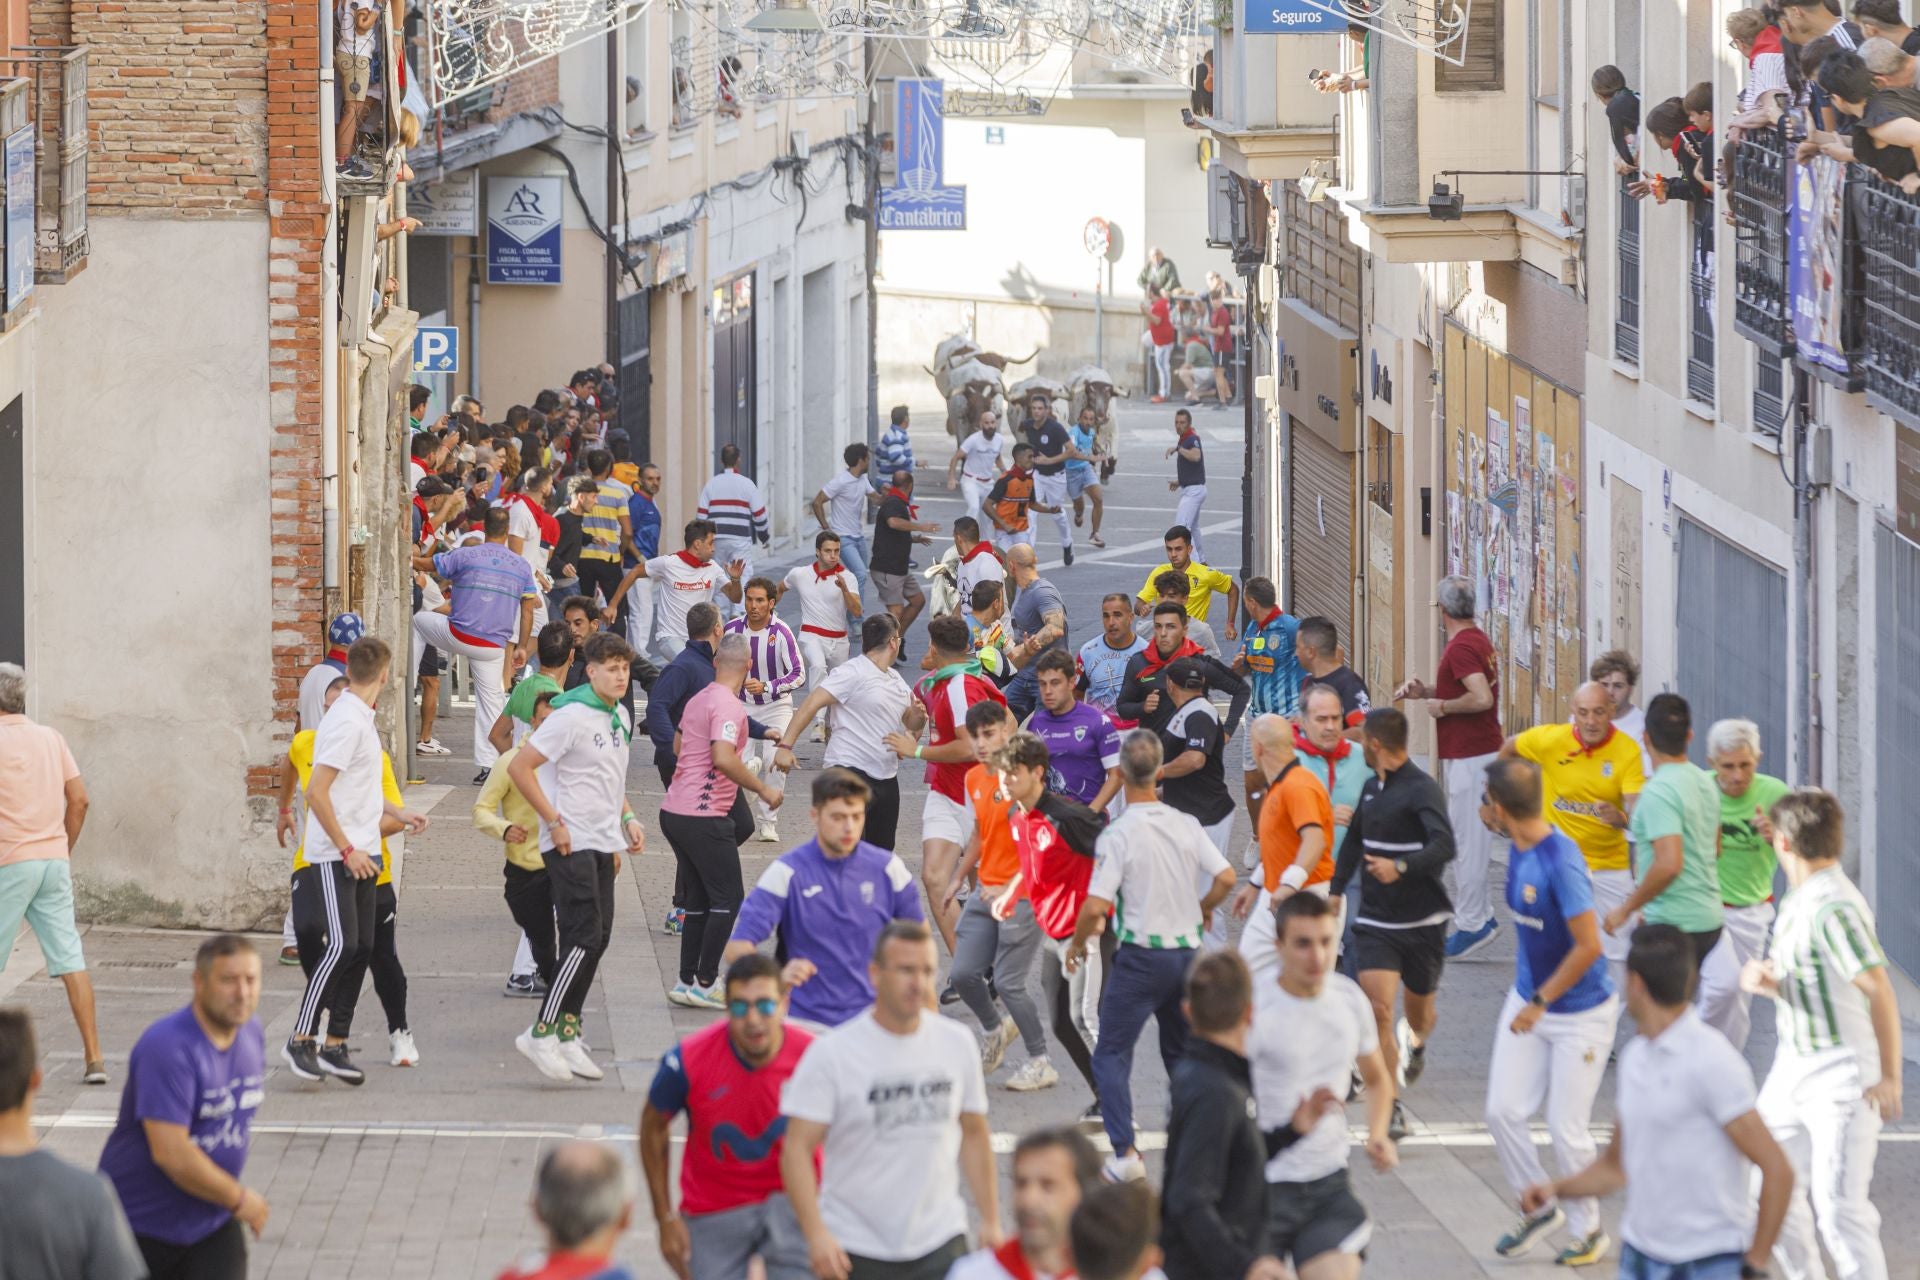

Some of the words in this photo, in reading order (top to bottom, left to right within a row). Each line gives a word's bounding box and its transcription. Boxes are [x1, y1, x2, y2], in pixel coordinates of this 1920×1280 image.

[1272, 9, 1322, 25] Seguros
[504, 189, 544, 215] AR
[881, 206, 962, 227] Cantábrico
[497, 255, 522, 263] LABORAL
[498, 247, 517, 255] FISCAL
[522, 247, 551, 256] CONTABLE
[422, 332, 449, 367] P
